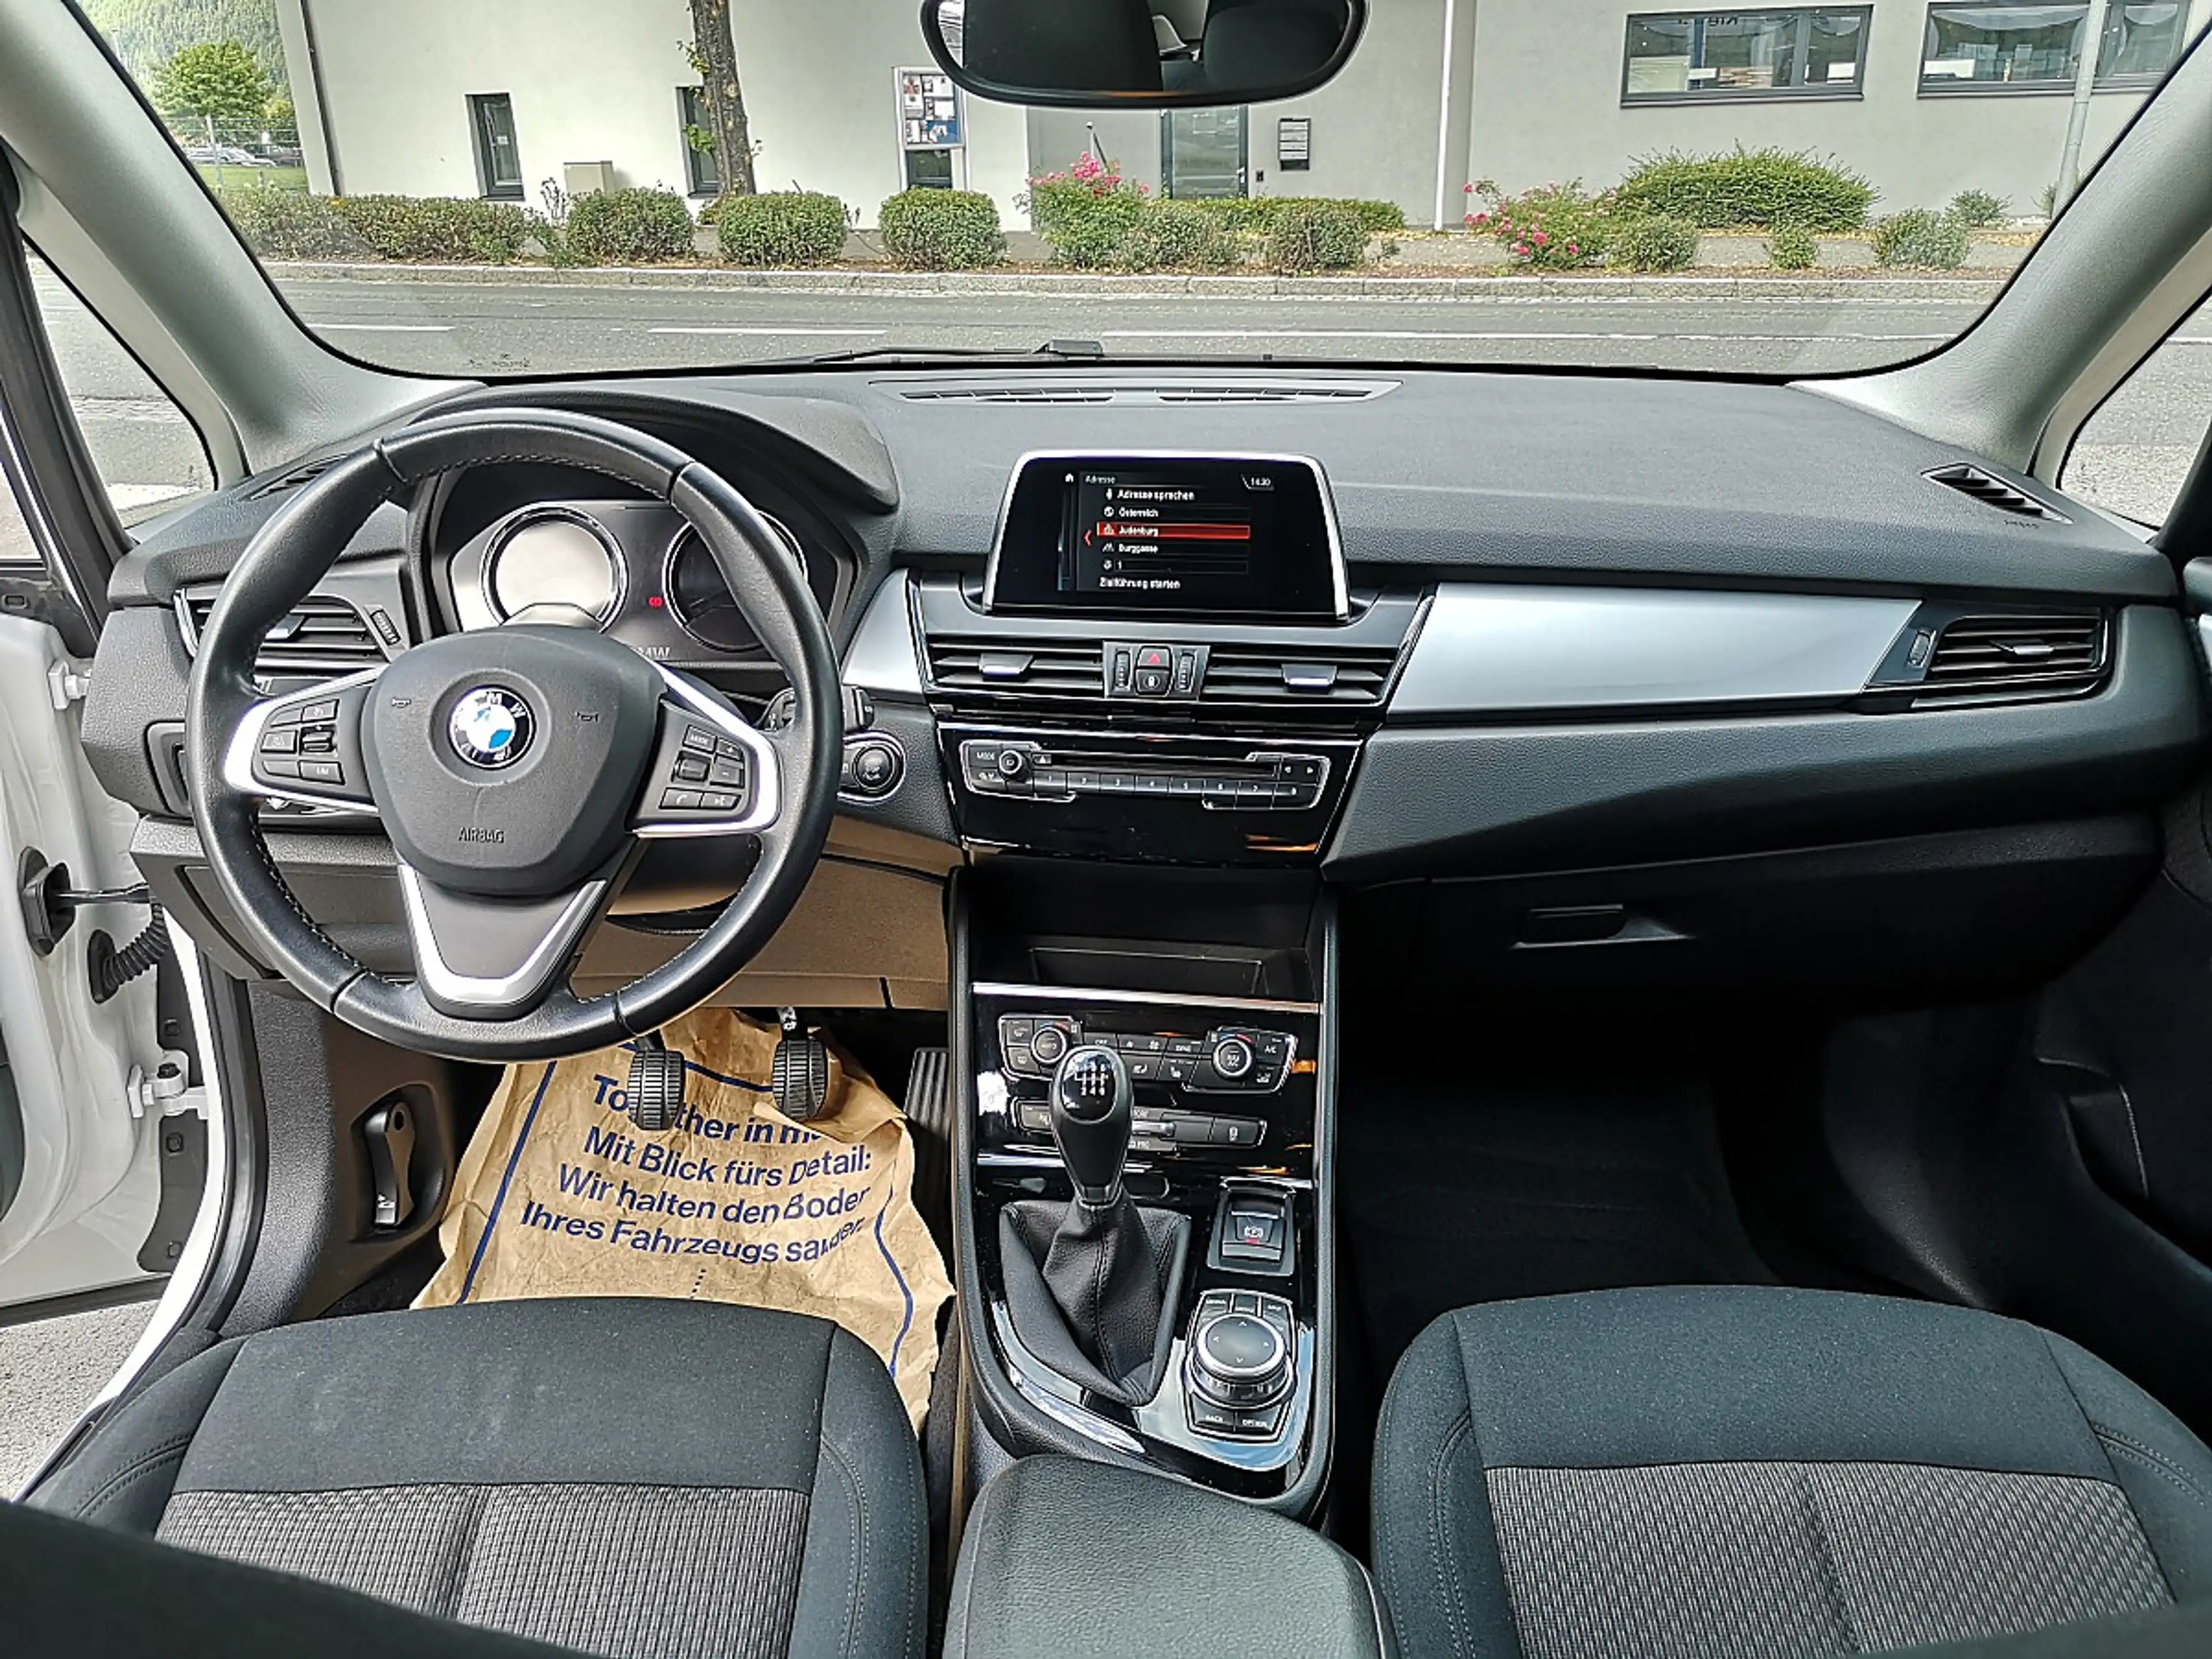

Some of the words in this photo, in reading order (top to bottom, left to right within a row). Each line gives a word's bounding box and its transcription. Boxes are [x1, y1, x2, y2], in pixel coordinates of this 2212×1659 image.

[1117, 489, 1153, 499] Adresse
[1154, 490, 1195, 502] sprechen
[1118, 507, 1159, 517] Österreich
[1118, 525, 1159, 537] Judenburg
[1118, 543, 1159, 554] Burggasse
[1099, 577, 1149, 590] Zielführung
[1150, 579, 1181, 589] starten
[459, 827, 505, 843] AIRBAG
[593, 1074, 740, 1142] Tother
[743, 1118, 774, 1143] in
[584, 1125, 637, 1165] Mit
[638, 1142, 718, 1182] Blick
[724, 1160, 783, 1187] fürs
[787, 1144, 871, 1185] Detail:
[559, 1162, 614, 1202] Wir
[616, 1180, 717, 1219] halten
[722, 1199, 781, 1224] den
[520, 1200, 605, 1240] Ihres
[609, 1218, 779, 1264] Fahrzeugs
